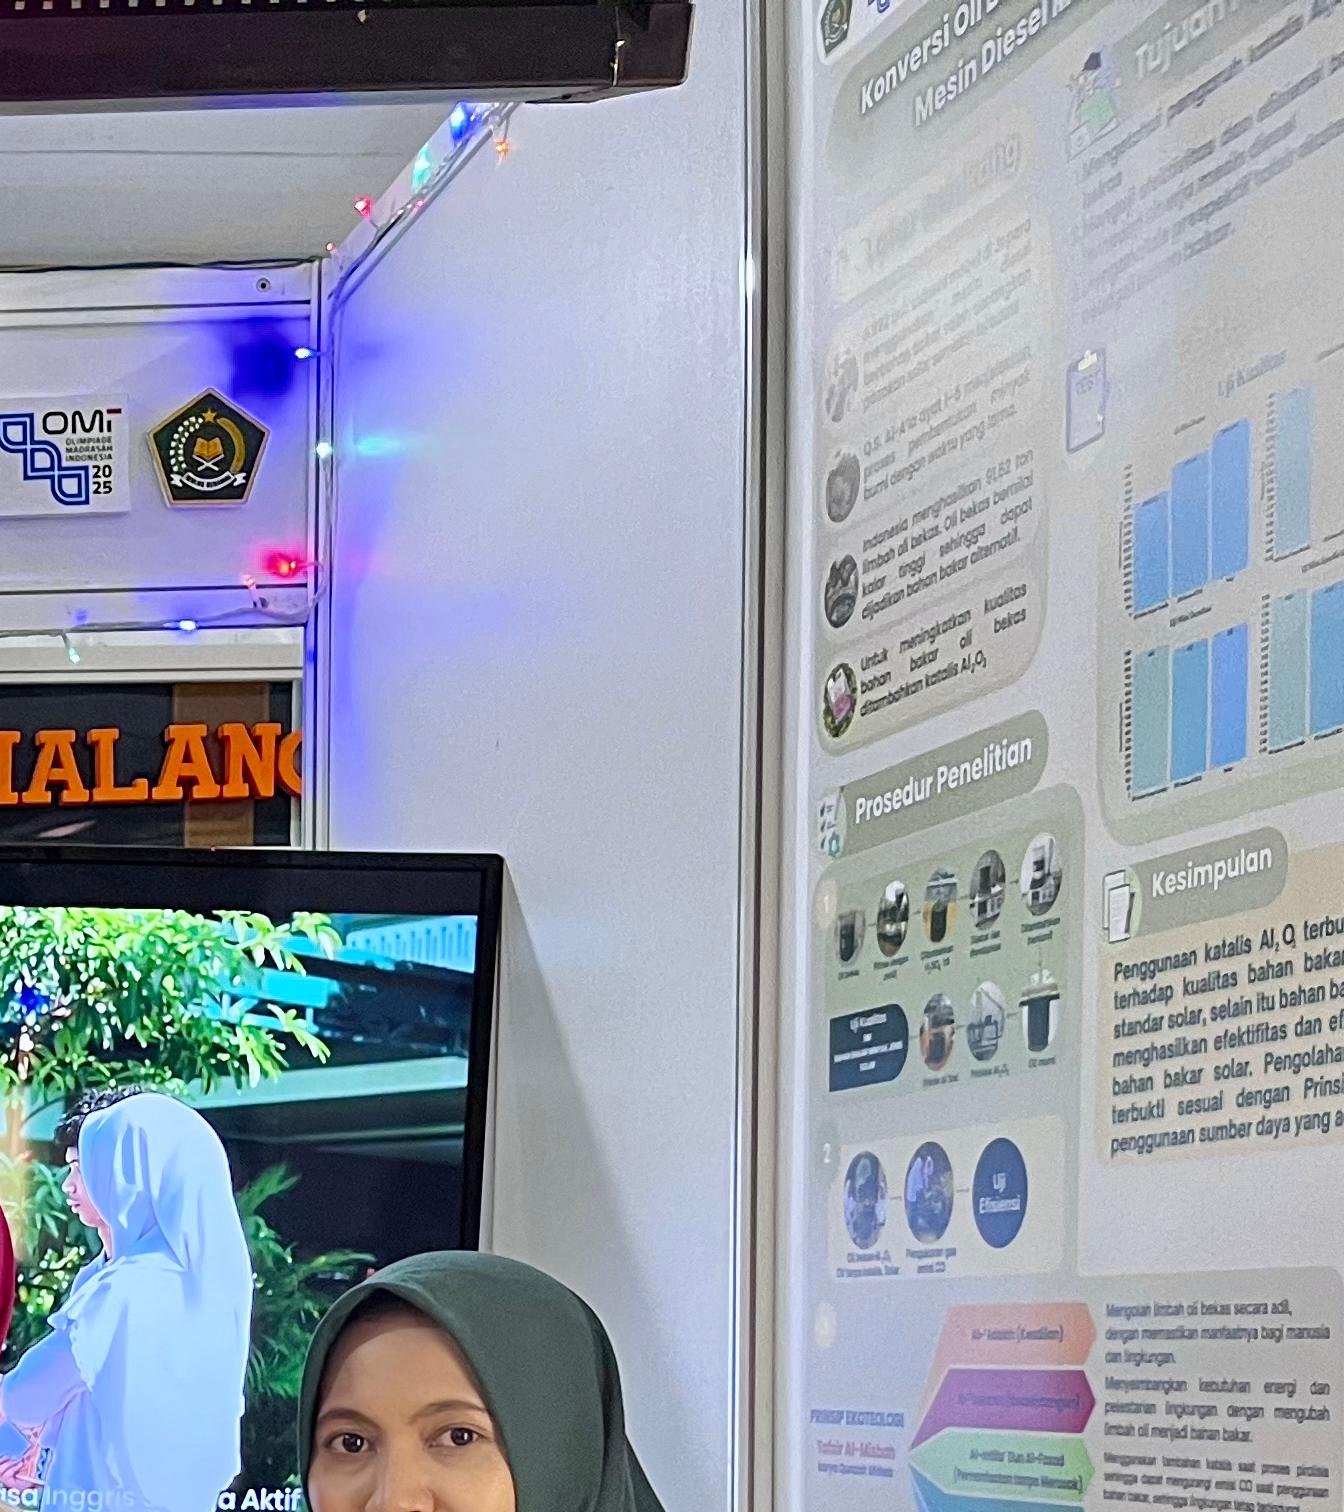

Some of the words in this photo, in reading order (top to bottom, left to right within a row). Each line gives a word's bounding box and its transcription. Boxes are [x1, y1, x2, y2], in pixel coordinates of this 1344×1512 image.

[861, 13, 950, 115] Konversi
[915, 57, 977, 127] Mesin
[981, 0, 1048, 76] Diesel
[65, 436, 112, 446] OLIMPIADE
[65, 445, 113, 454] MADRASAH
[65, 453, 113, 462] INDONESIA
[92, 465, 113, 479] 20
[92, 480, 113, 495] 25
[983, 582, 1027, 615] kualitas
[860, 670, 892, 696] bahan
[909, 648, 939, 673] bakar
[959, 628, 974, 650] oli
[993, 608, 1027, 634] bekas
[924, 658, 960, 690] katalis
[855, 774, 934, 825] Prosedur
[936, 736, 1032, 794] Penelitian
[1152, 847, 1273, 898] Kesimpulan
[1113, 949, 1198, 983] Penggunaan
[1204, 934, 1252, 964] katalis
[1113, 982, 1174, 1011] terhadap
[1182, 970, 1238, 997] kualitas
[1247, 959, 1294, 984] bahan
[1113, 1013, 1165, 1040] standar
[1167, 1006, 1208, 1030] solar,
[1210, 996, 1253, 1022] selain
[1256, 990, 1276, 1012] itu
[1279, 984, 1326, 1009] bahan
[1112, 1036, 1208, 1068] menghasilkan
[1213, 1022, 1288, 1052] efektifitas
[1294, 1015, 1322, 1038] dan
[1112, 1072, 1154, 1097] bahan
[1163, 1065, 1204, 1090] bakar
[1213, 1058, 1253, 1081] solar.
[1112, 1098, 1165, 1125] terbukti
[1176, 1089, 1224, 1117] sesuai
[1235, 1085, 1291, 1110] dengan
[1110, 1128, 1196, 1159] penggunaan
[1198, 1119, 1253, 1144] sumber
[1255, 1115, 1291, 1140] daya
[1294, 1110, 1331, 1138] yang
[1200, 1300, 1232, 1316] bekas
[1233, 1302, 1269, 1316] secara
[45, 1484, 135, 1512] Inggris
[240, 1488, 302, 1512] Aktif
